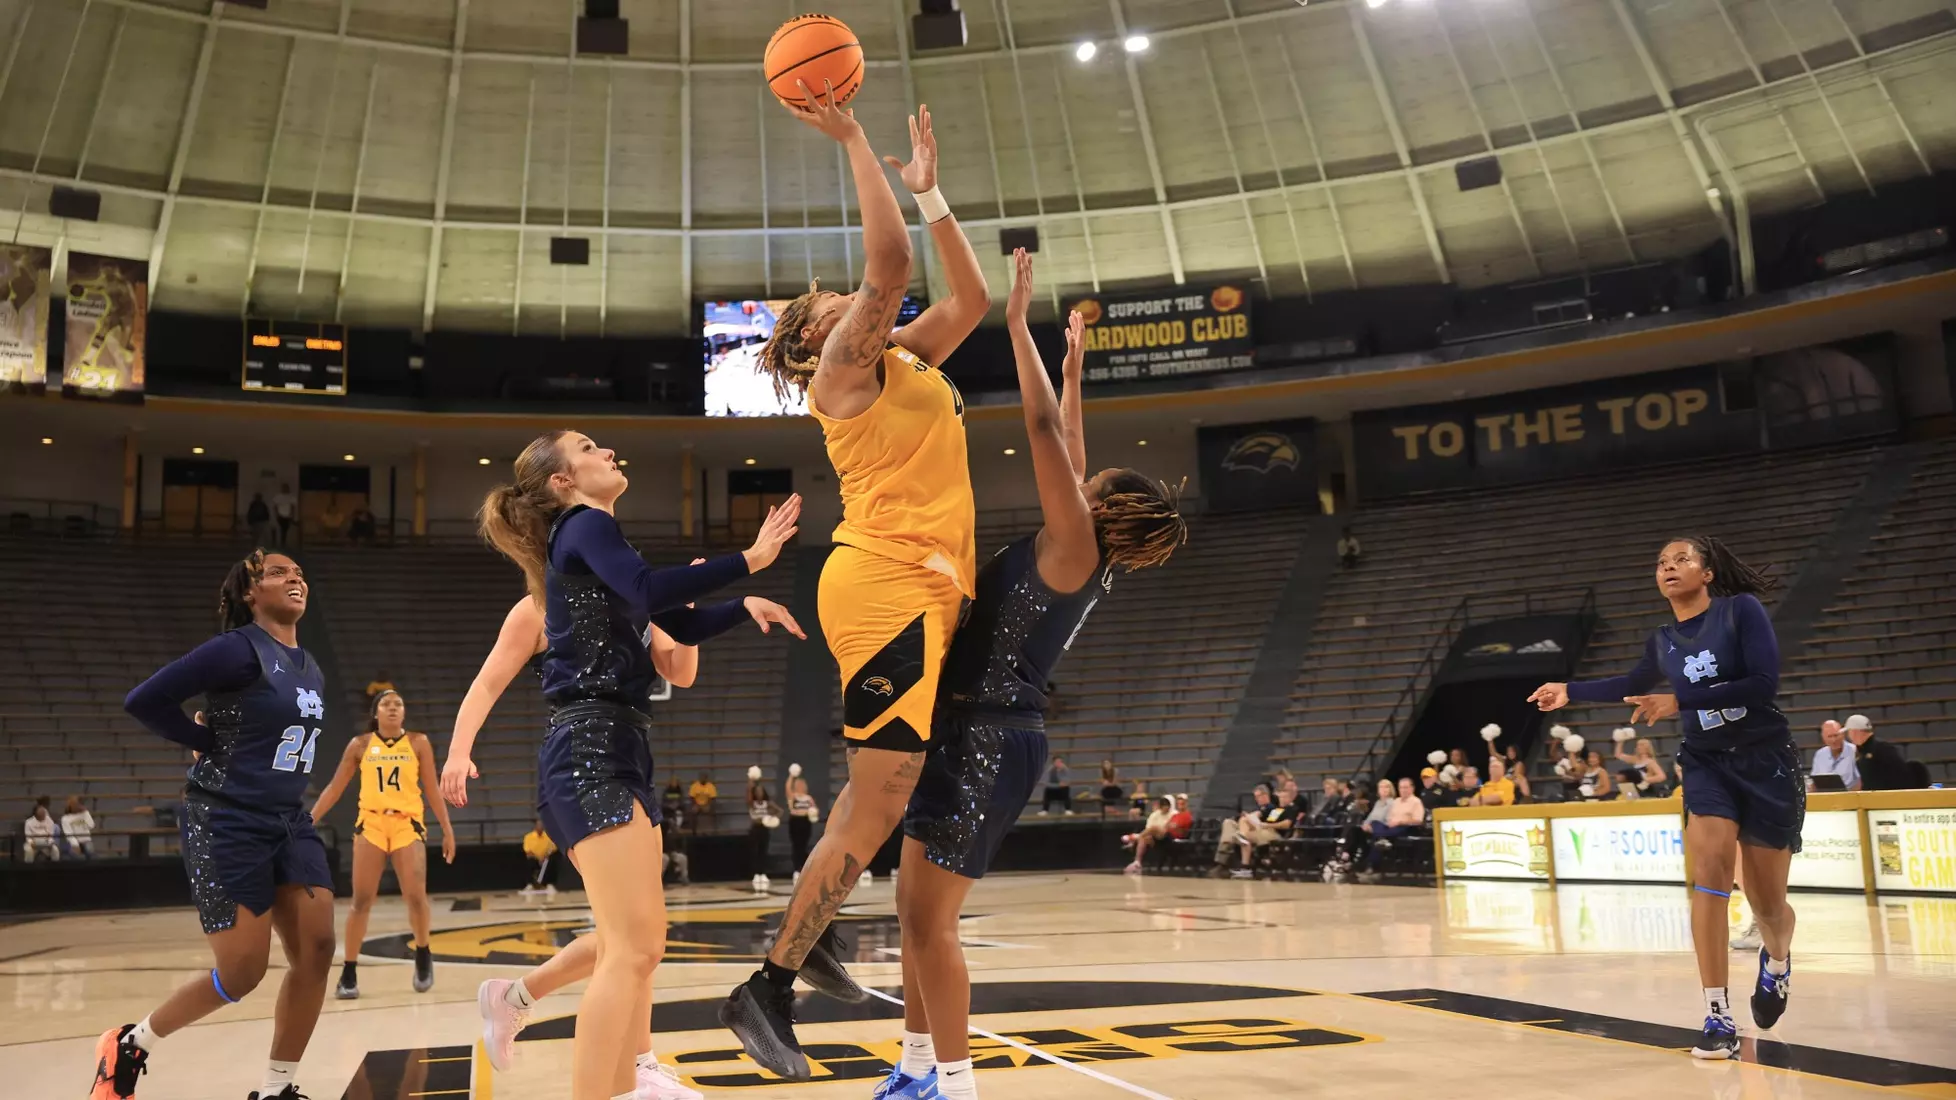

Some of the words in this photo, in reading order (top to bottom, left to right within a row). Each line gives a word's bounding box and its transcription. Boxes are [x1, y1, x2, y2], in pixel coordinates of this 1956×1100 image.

[1108, 300, 1173, 318] SUPPORT
[1174, 295, 1205, 312] THE
[1083, 320, 1186, 351] ARDWOOD
[1192, 313, 1249, 343] CLUB
[1391, 421, 1464, 460] TO
[1474, 404, 1585, 453] THE
[1597, 388, 1709, 435] TOP
[272, 725, 322, 773] 24
[376, 766, 401, 793] 14
[1937, 814, 1951, 826] app
